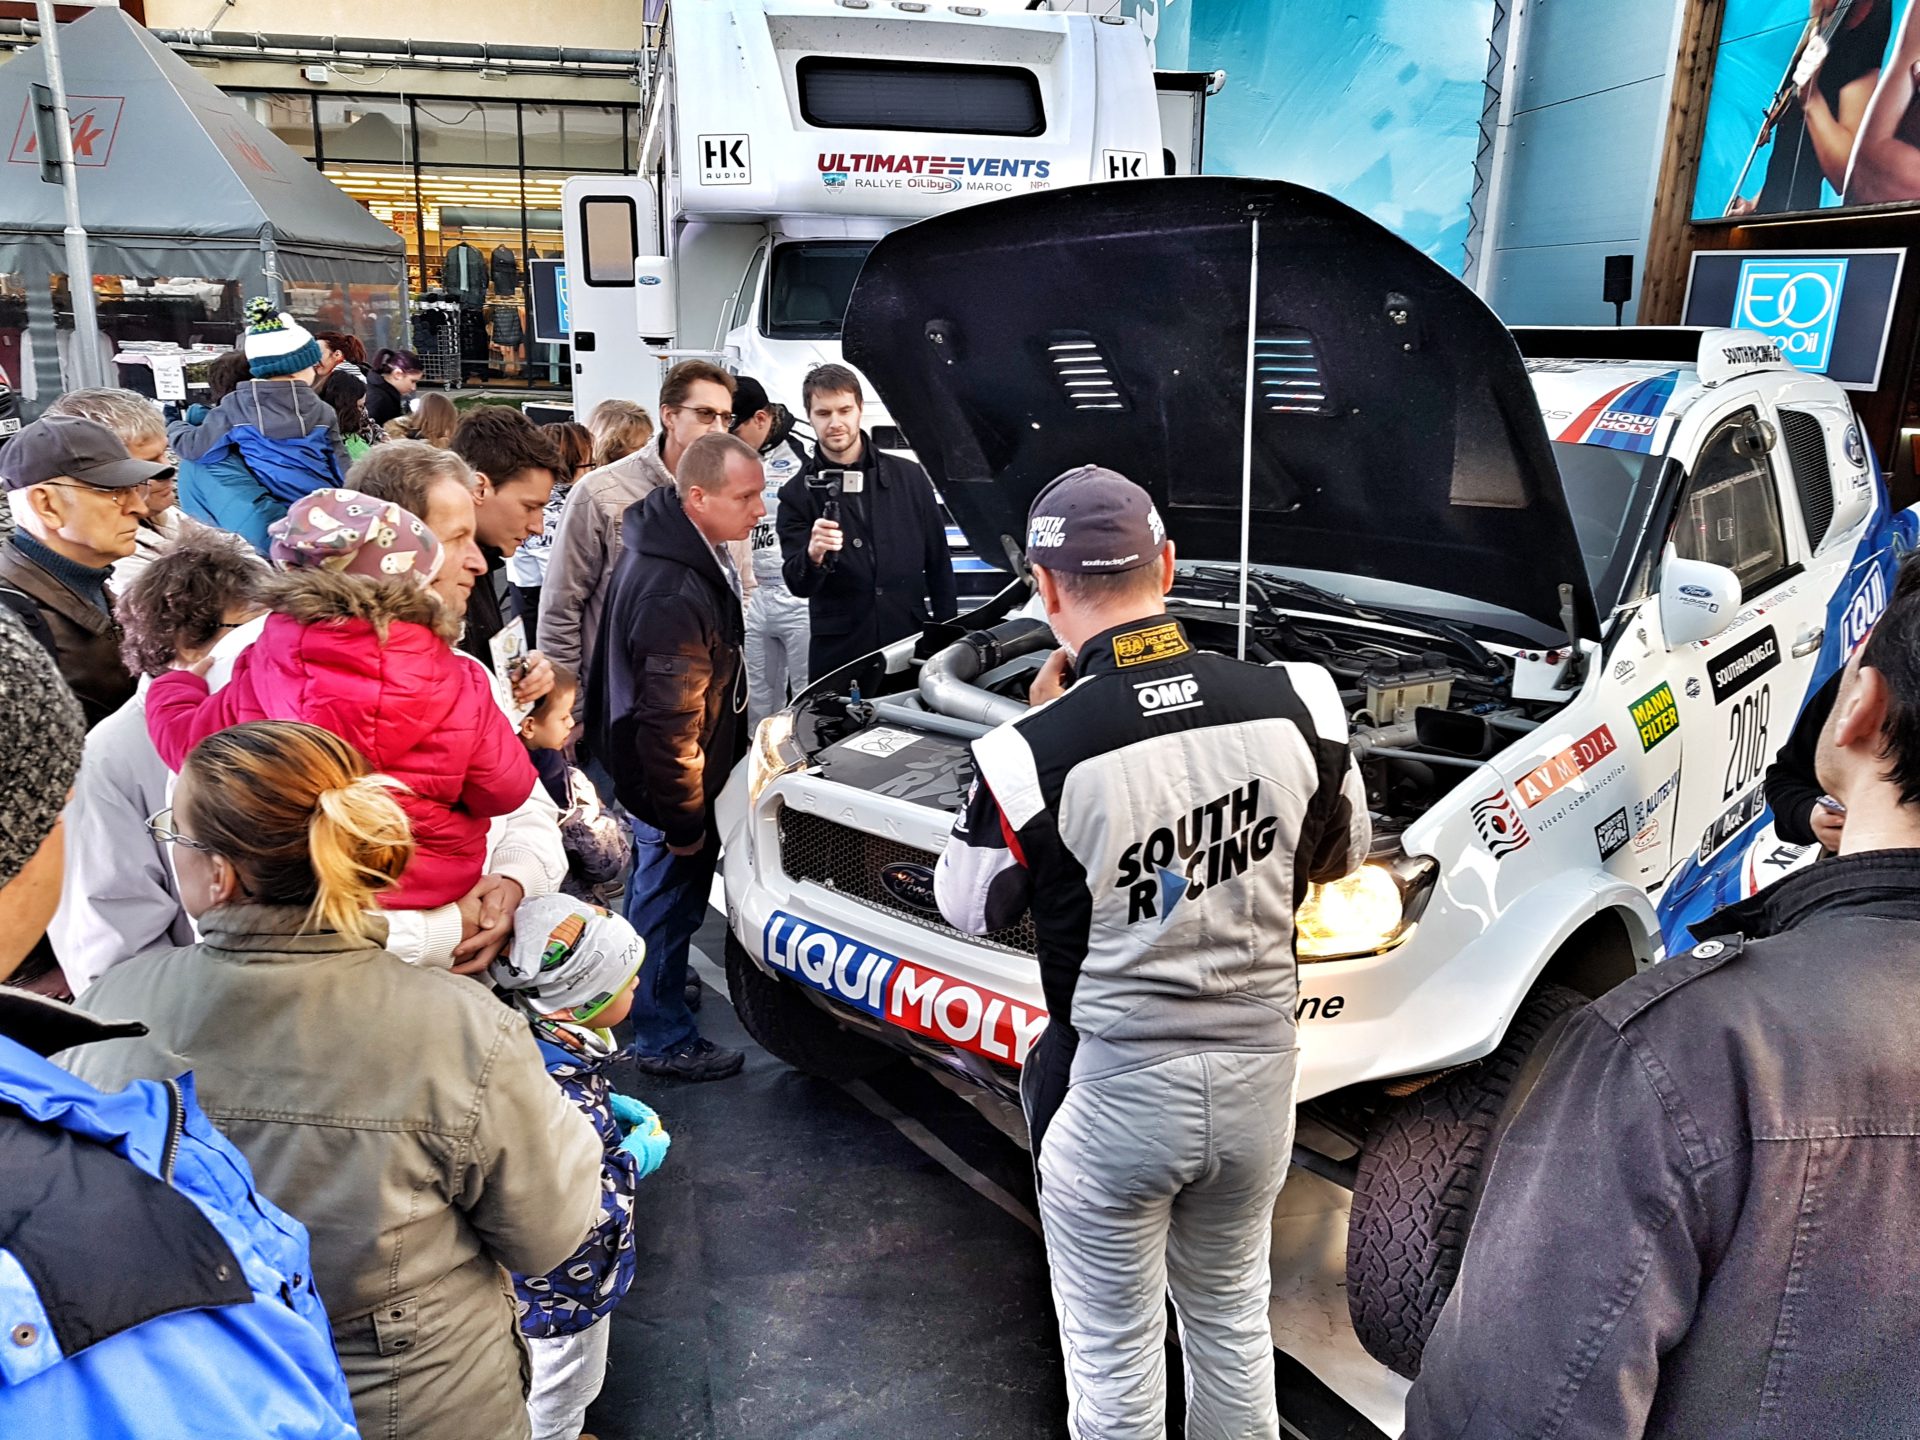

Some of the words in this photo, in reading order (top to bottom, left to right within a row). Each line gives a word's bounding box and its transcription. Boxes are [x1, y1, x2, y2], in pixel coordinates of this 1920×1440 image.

[705, 140, 746, 168] HK
[1109, 155, 1142, 179] HK
[855, 179, 902, 188] RALLYE
[966, 182, 1012, 192] MAROC
[1600, 420, 1653, 434] MOLY
[1602, 412, 1657, 424] LIQUI
[1137, 680, 1199, 709] OMP
[1632, 686, 1674, 727] MANN
[1640, 706, 1679, 748] FILTER
[1722, 683, 1770, 803] 2018
[1538, 807, 1567, 832] visual
[1569, 764, 1627, 811] communication
[1114, 778, 1260, 888] SOUTH
[768, 916, 893, 1009] LIQUI
[891, 966, 1050, 1065] MOLY
[1296, 979, 1345, 1019] ne
